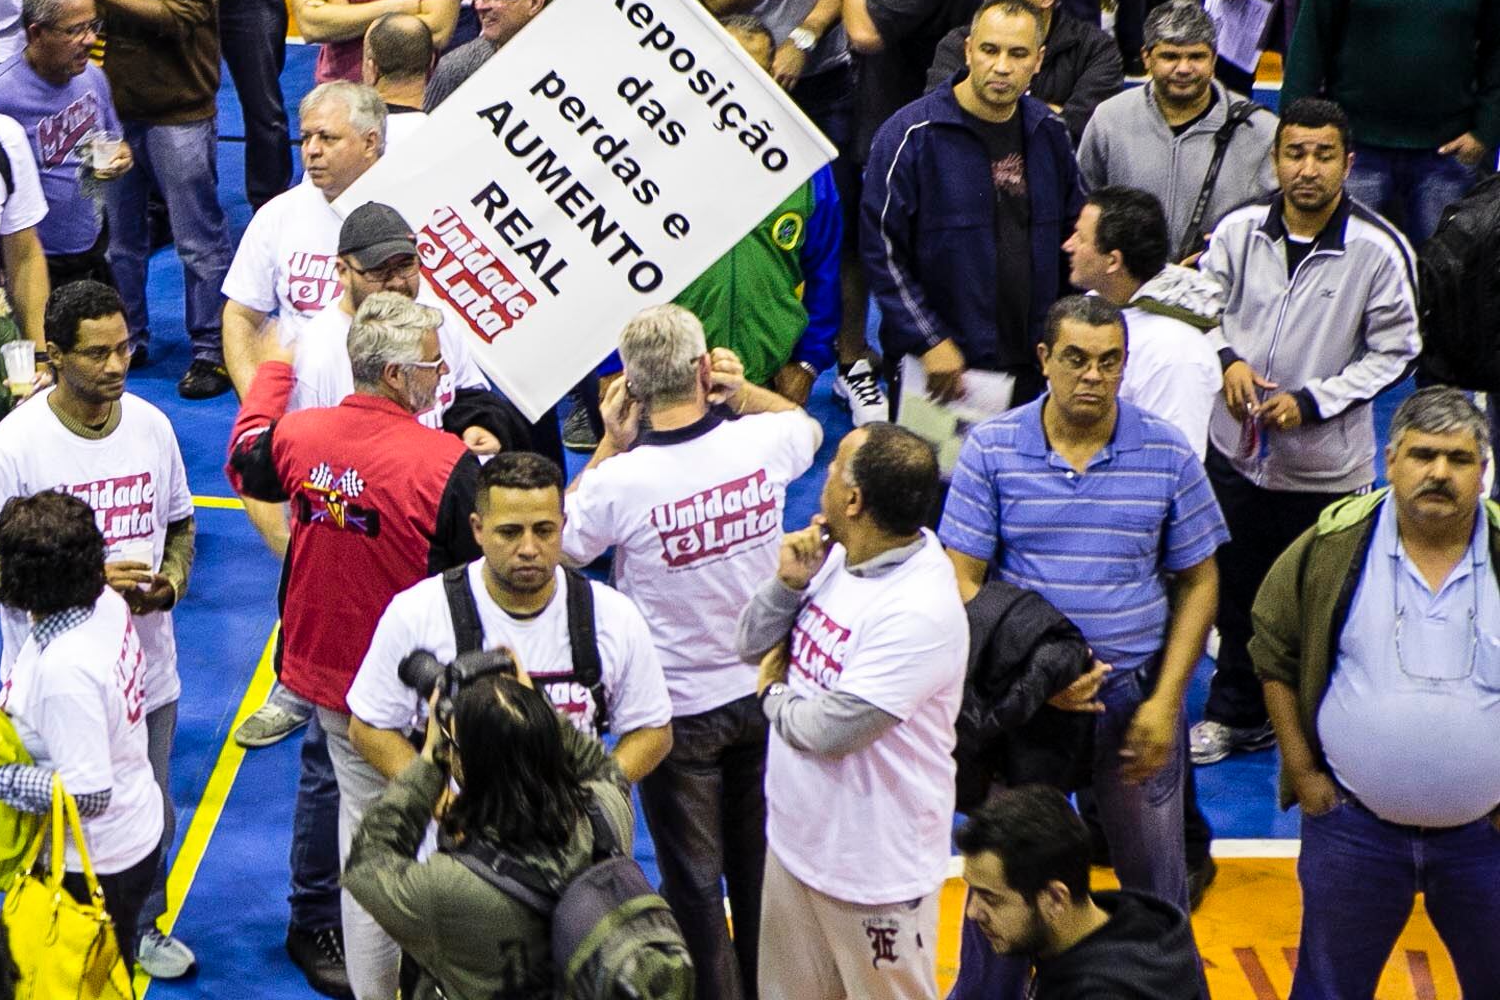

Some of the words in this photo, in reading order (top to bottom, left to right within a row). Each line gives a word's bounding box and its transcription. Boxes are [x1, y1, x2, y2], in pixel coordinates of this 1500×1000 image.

[530, 70, 660, 206] perdas
[663, 212, 691, 240] e
[617, 75, 687, 147] das
[470, 181, 572, 297] REAL
[476, 101, 664, 294] AUMENTO
[431, 206, 529, 318] Unidade
[432, 261, 507, 339] Luta
[653, 476, 775, 533] Unidade
[703, 509, 778, 551] Luta
